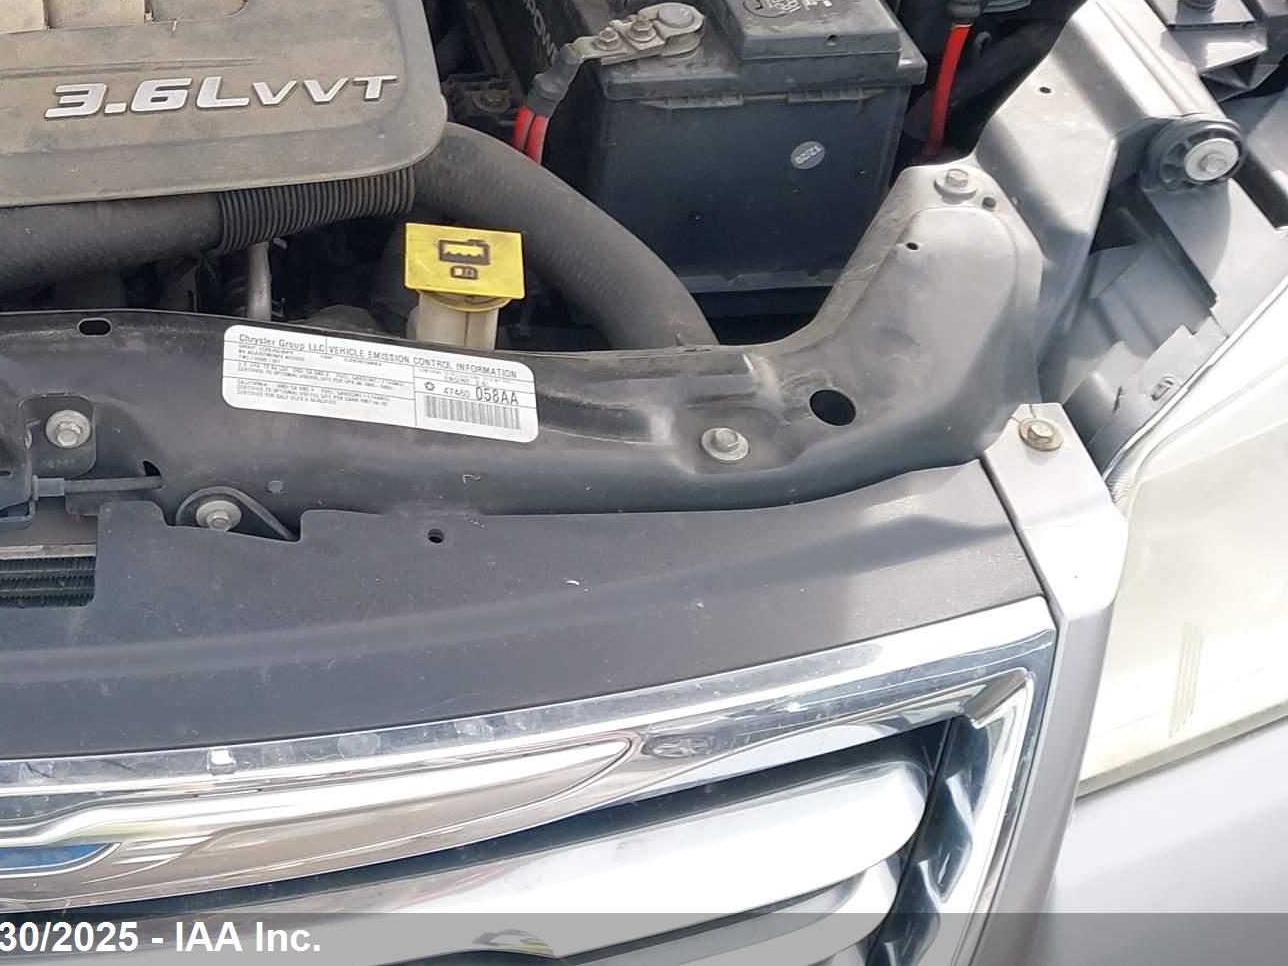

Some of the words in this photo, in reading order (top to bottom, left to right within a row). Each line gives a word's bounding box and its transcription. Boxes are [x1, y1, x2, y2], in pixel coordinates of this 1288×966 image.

[238, 333, 276, 347] Chrysler
[278, 339, 306, 352] Group
[308, 343, 325, 353] LLC
[329, 345, 365, 357] VEHICLE
[368, 350, 410, 364] EMISSION
[413, 356, 452, 370] CONTROL
[456, 362, 518, 379] INFORMATION
